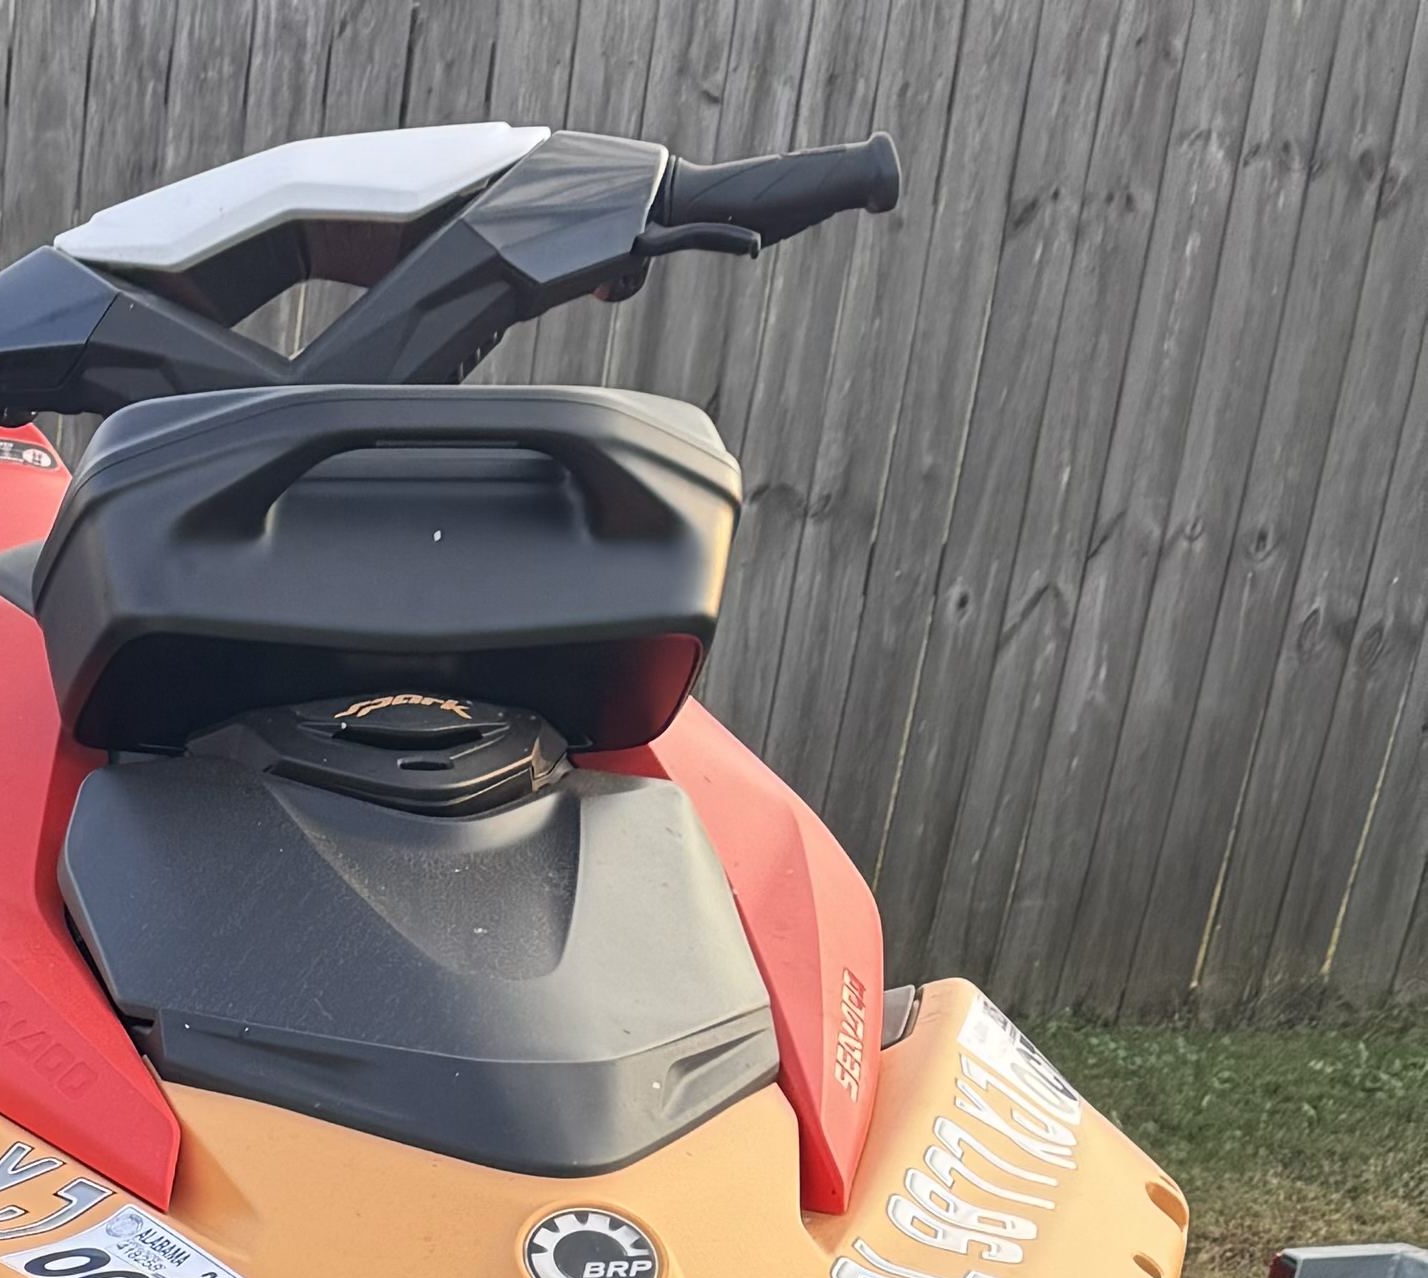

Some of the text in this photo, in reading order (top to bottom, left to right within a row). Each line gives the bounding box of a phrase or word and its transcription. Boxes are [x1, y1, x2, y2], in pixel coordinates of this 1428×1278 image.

[953, 1052, 1079, 1171] XJ
[135, 1228, 191, 1267] ALABAMA
[582, 1260, 653, 1278] BRP
